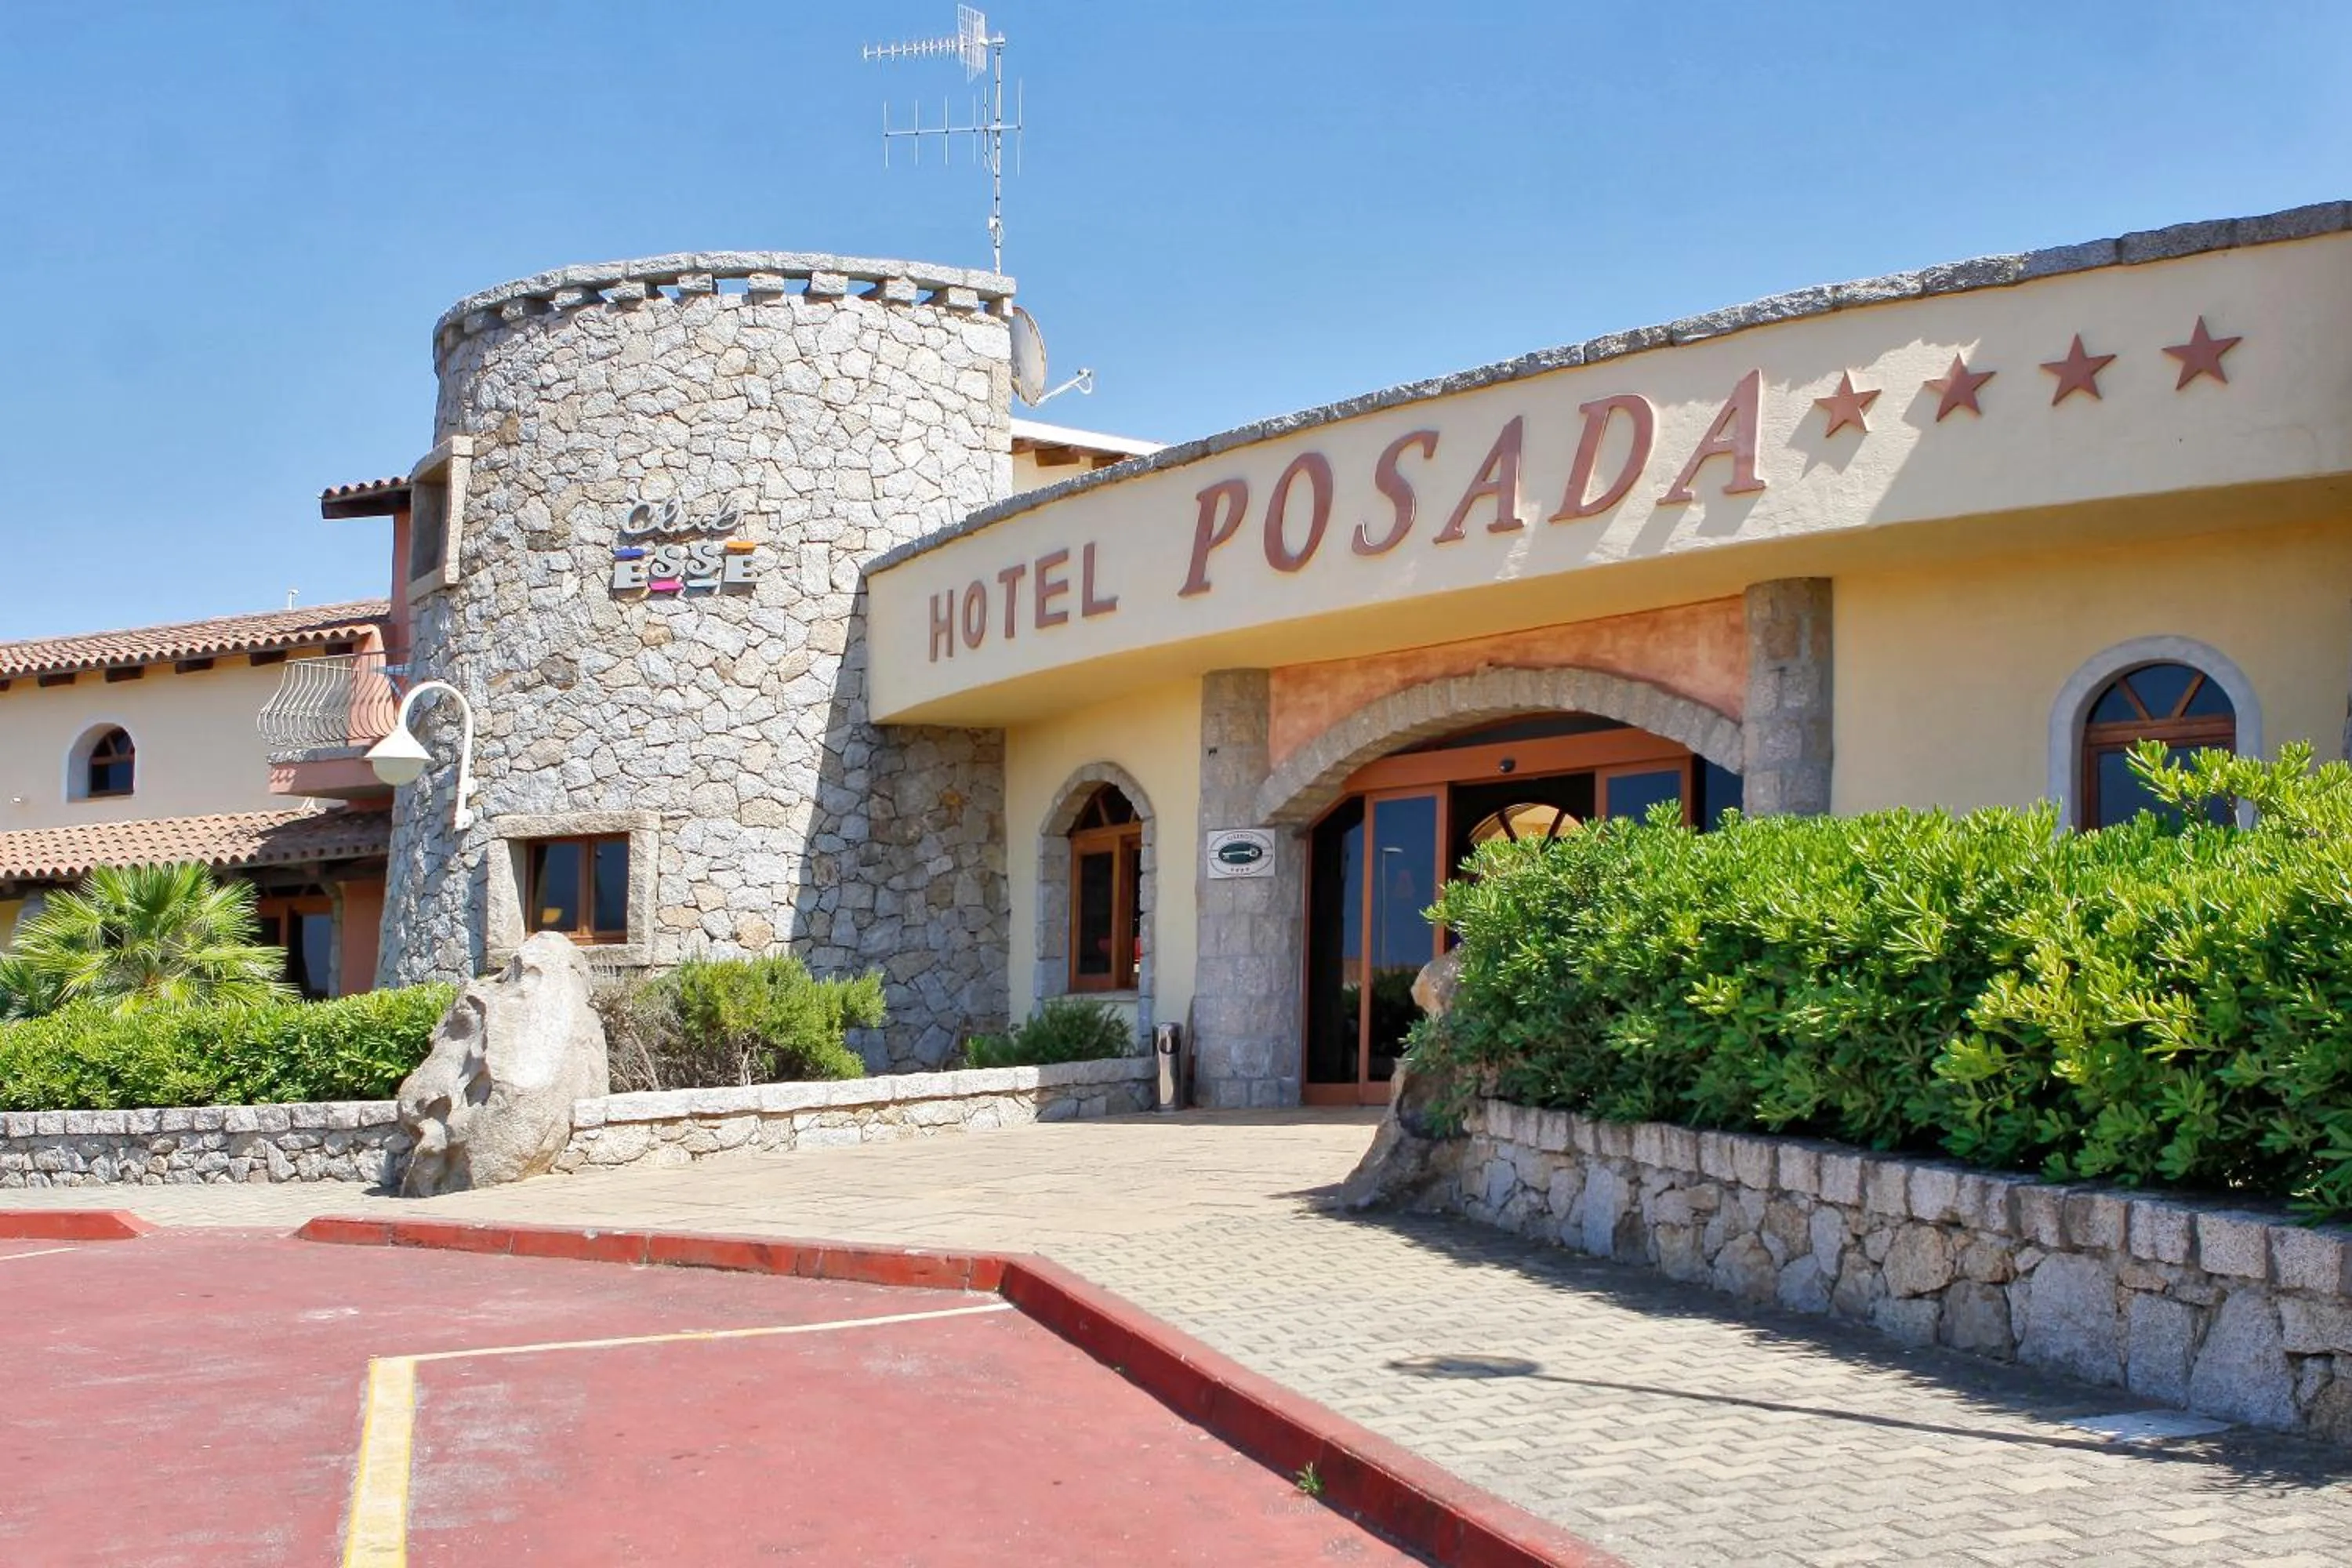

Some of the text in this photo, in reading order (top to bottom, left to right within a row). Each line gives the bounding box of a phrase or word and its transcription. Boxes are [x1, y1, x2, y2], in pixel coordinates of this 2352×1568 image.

[623, 495, 742, 535] Club
[929, 368, 1766, 662] HOTEL POSADA
[613, 540, 758, 589] ESSE
